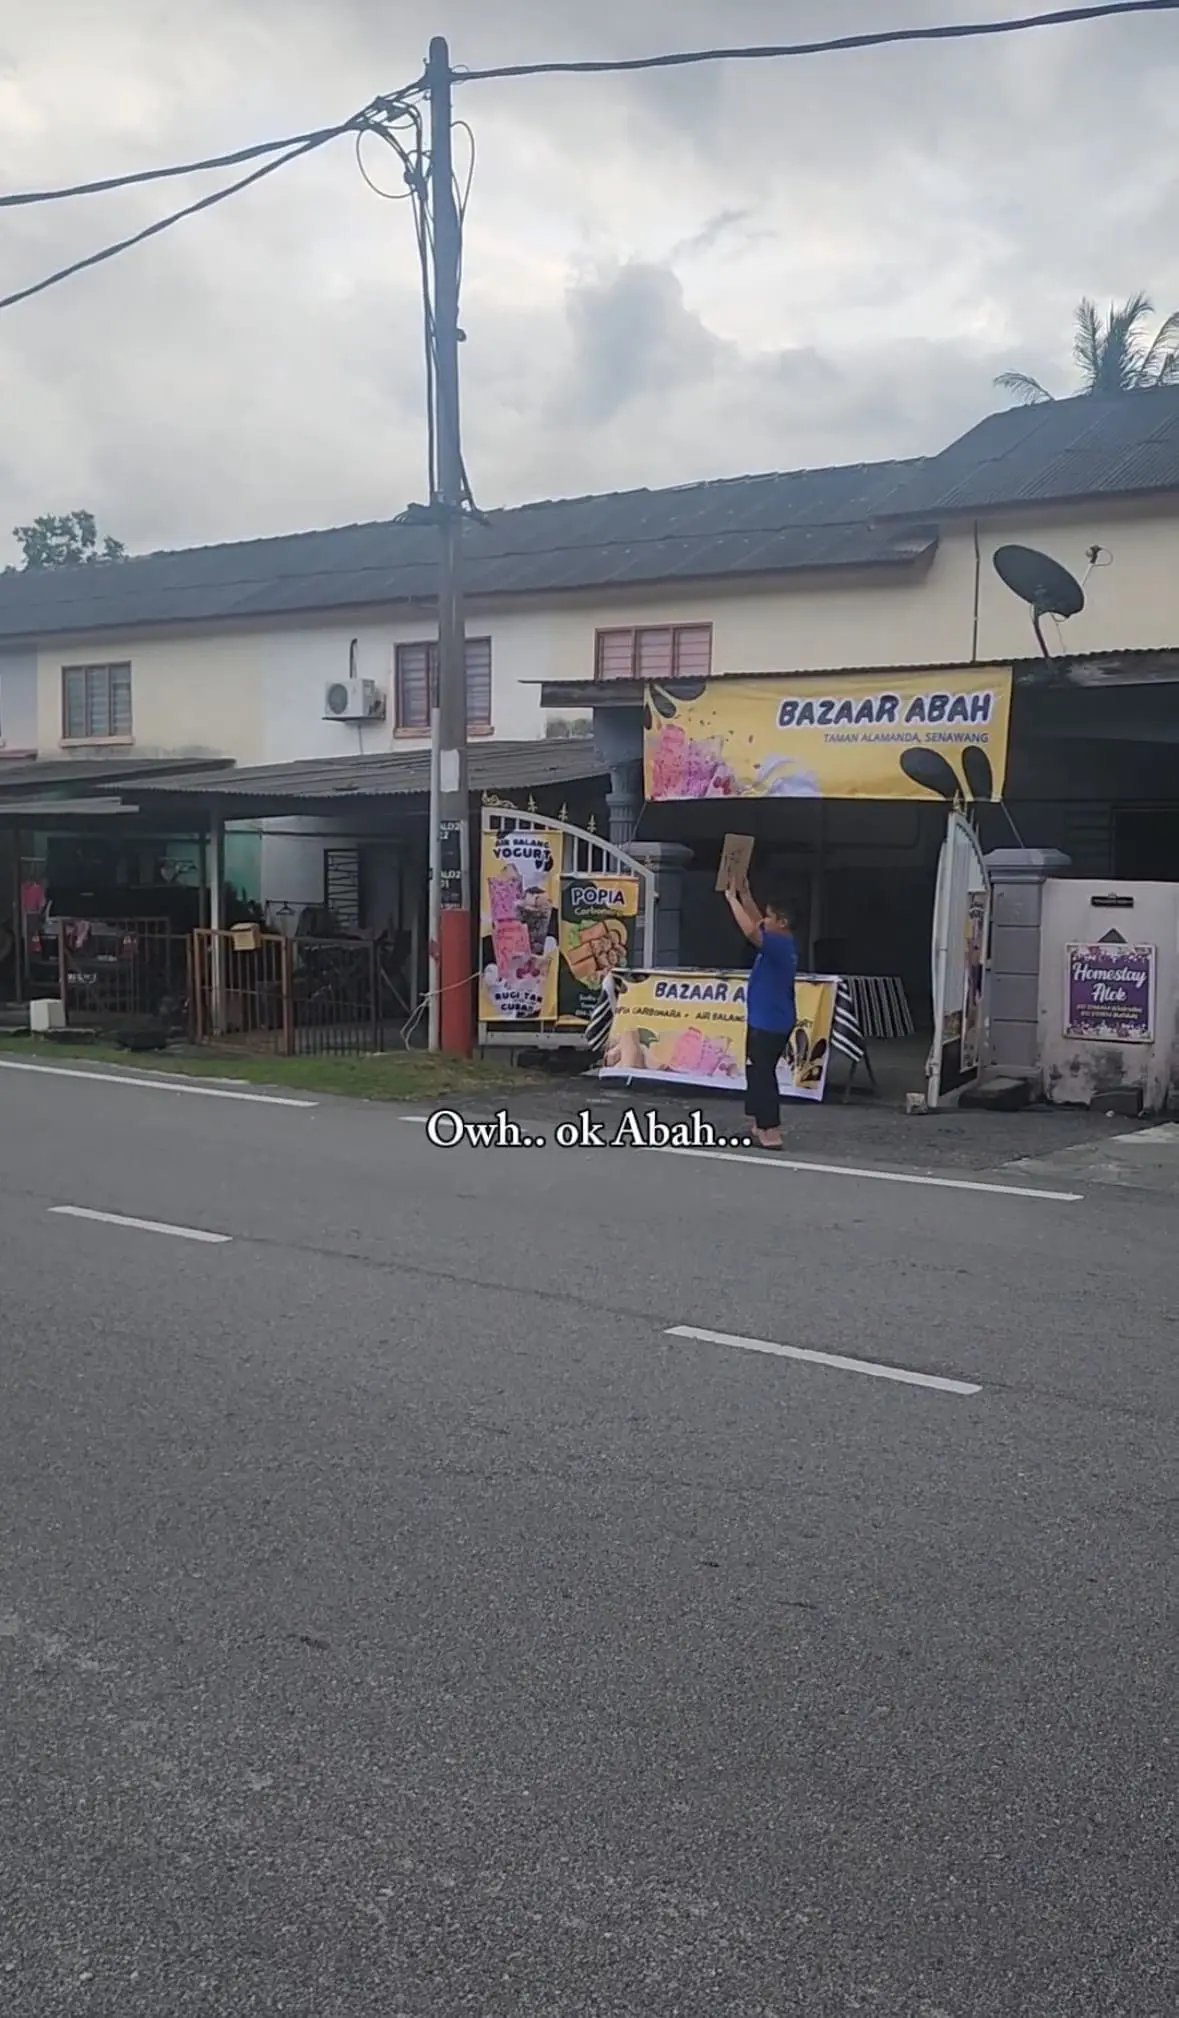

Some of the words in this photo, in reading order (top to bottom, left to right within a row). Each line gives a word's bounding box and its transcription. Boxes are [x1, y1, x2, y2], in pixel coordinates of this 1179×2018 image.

[779, 694, 900, 727] BAZAAR
[905, 692, 993, 724] ABAH
[824, 733, 858, 743] TAMAN
[925, 732, 988, 743] SENAWANG
[492, 848, 551, 860] YOGURT
[572, 888, 626, 906] POPIA
[1072, 963, 1146, 989] Homestay
[654, 981, 728, 1001] BAZAAR
